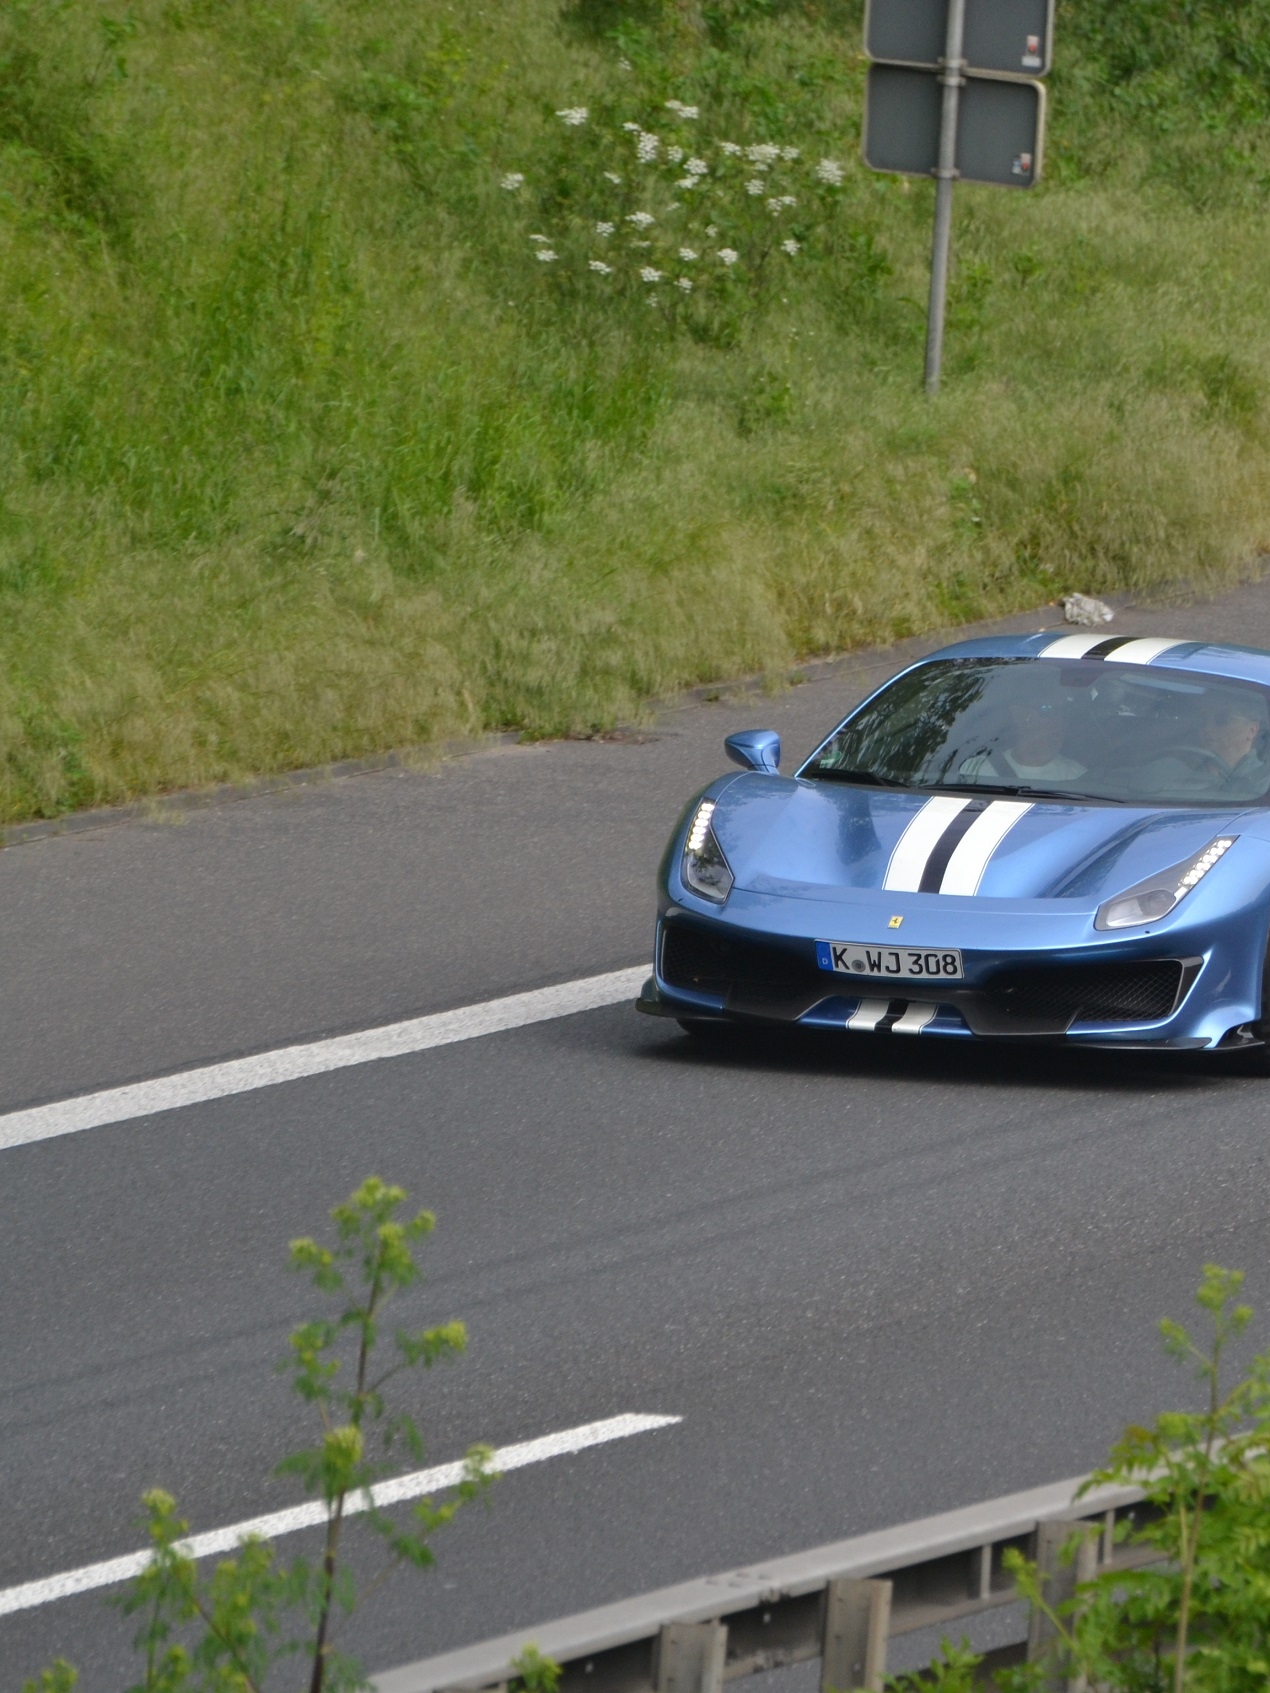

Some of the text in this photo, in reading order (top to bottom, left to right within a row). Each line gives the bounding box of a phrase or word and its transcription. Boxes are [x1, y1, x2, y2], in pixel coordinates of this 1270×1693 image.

[821, 958, 829, 966] D
[832, 947, 958, 976] K WJ 308
